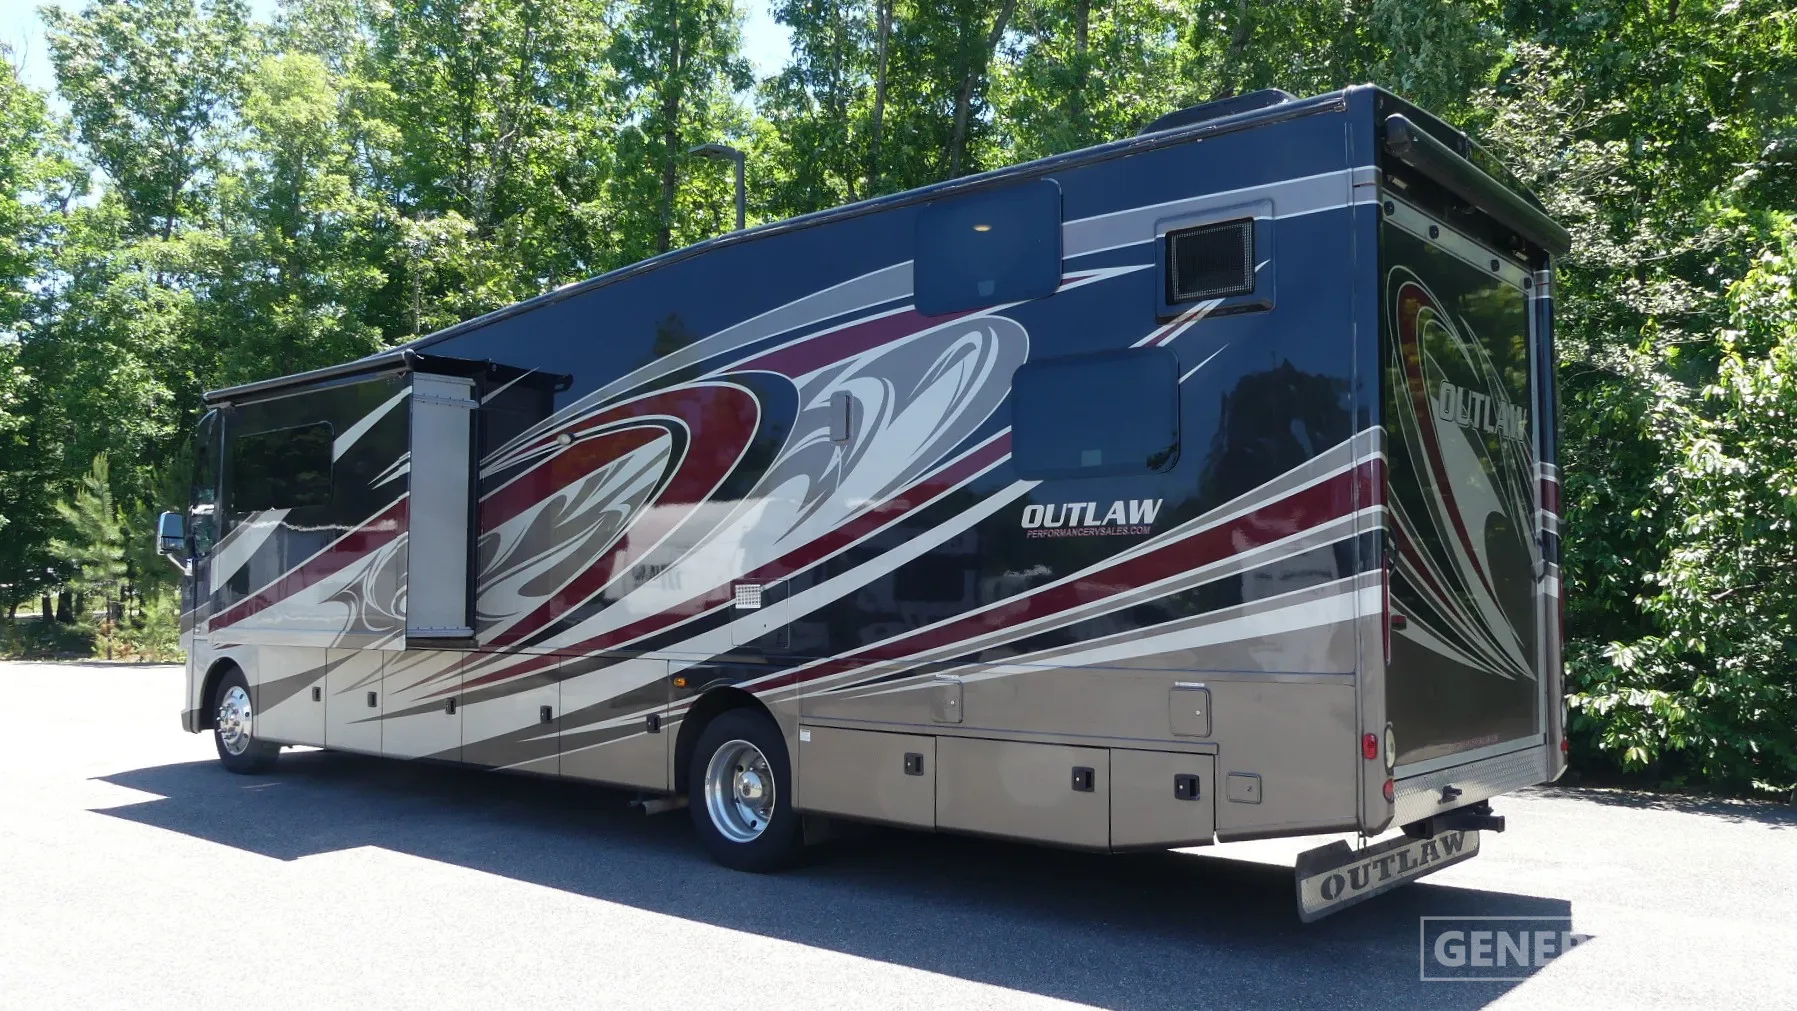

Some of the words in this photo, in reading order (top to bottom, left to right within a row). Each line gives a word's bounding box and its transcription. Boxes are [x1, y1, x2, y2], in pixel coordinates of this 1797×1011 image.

[1438, 379, 1527, 443] OUTLAW
[1021, 499, 1163, 528] OUTLAW
[1026, 526, 1151, 539] PERFORMANCERVSALES.COM
[1320, 830, 1466, 901] OUTLAW
